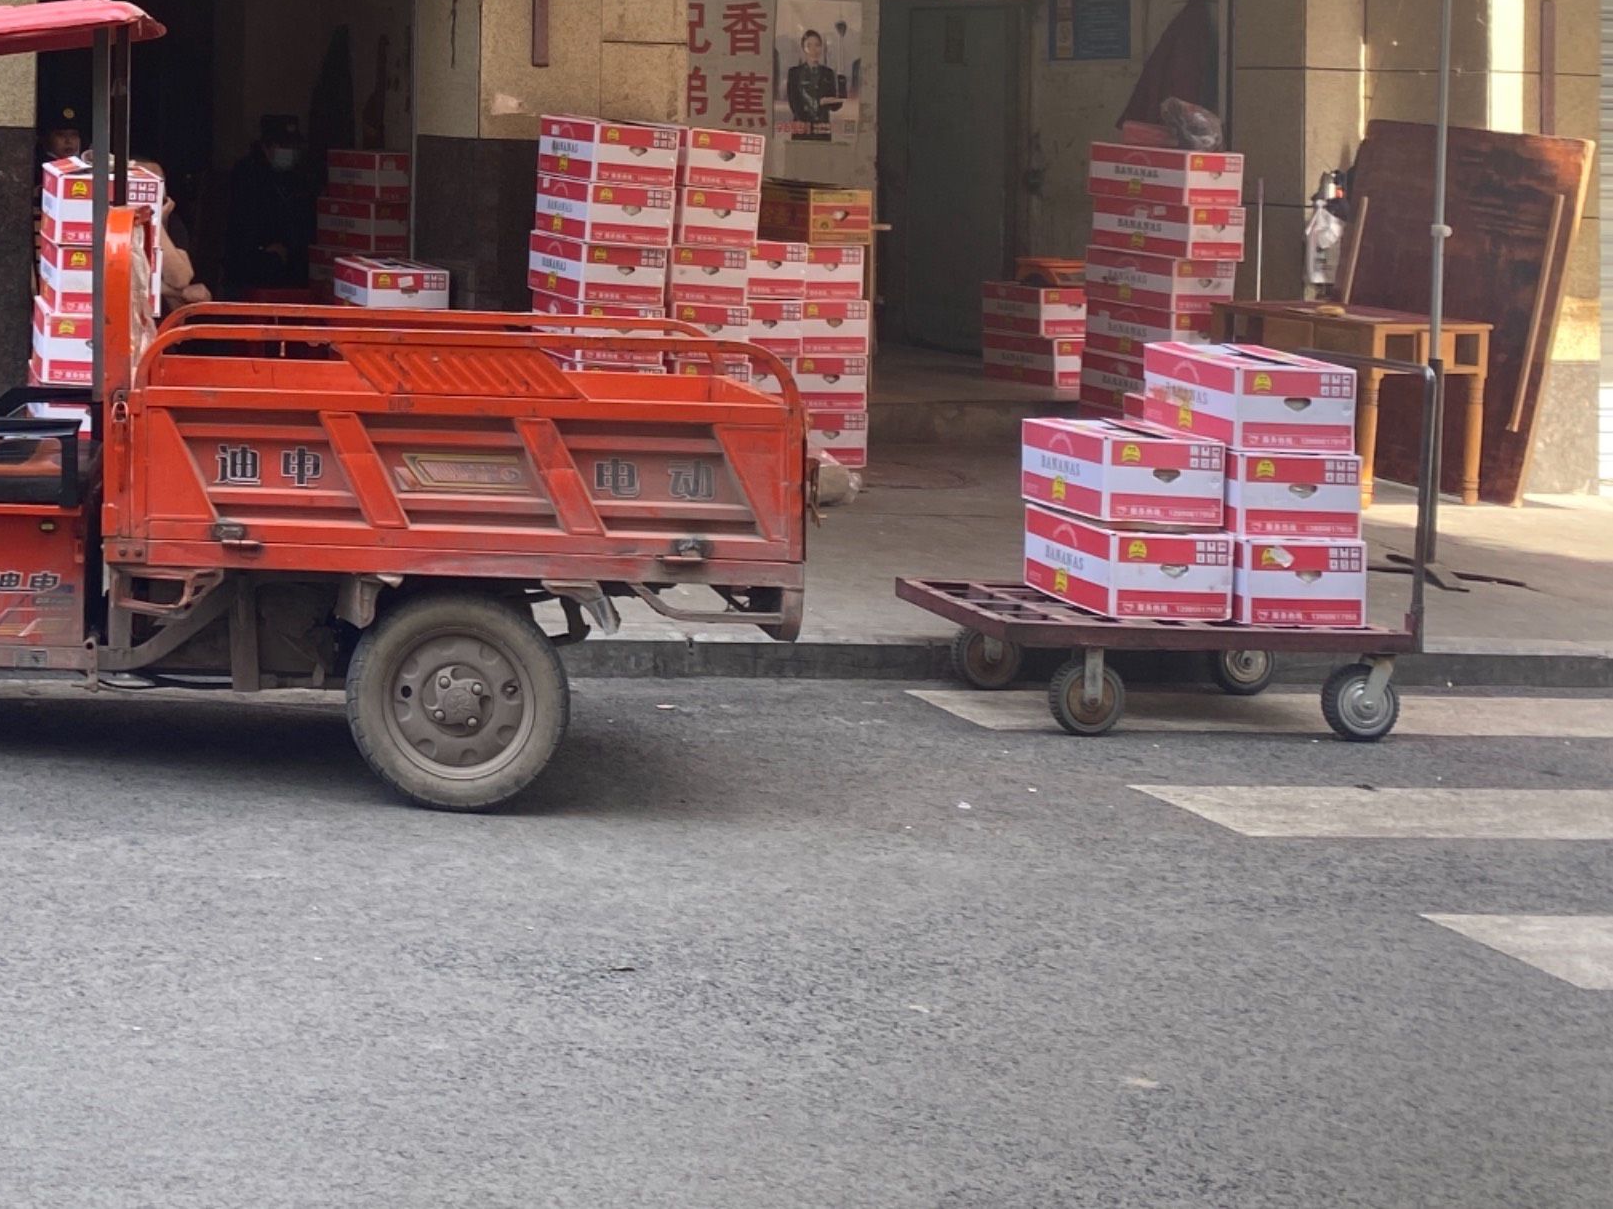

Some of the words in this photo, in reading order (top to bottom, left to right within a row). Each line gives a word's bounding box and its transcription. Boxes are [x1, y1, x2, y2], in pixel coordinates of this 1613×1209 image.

[721, 1, 769, 128] 香蕉
[212, 443, 323, 487] 迪申
[595, 456, 715, 501] 电动
[1041, 454, 1081, 476] BANANAS
[1045, 544, 1084, 571] BANANAS
